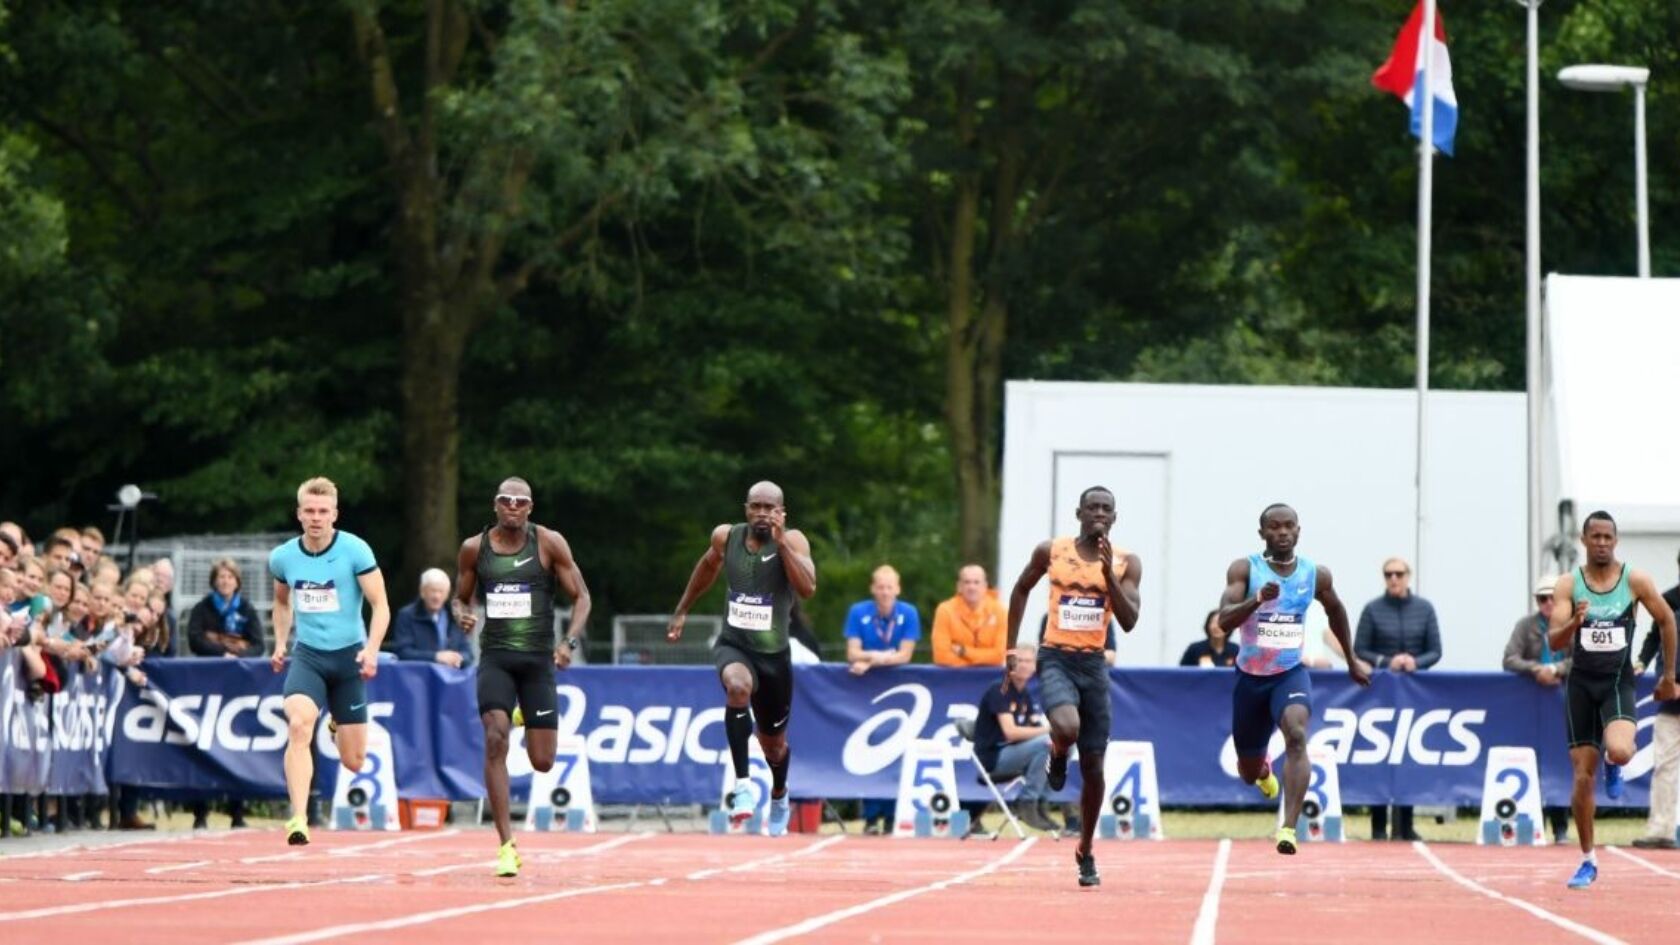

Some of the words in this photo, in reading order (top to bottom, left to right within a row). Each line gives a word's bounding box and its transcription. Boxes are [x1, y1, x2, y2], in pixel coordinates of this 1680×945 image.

[731, 606, 769, 621] Martina
[1063, 610, 1100, 622] Burnet
[1591, 631, 1613, 644] 601
[123, 690, 290, 752] asics
[1309, 708, 1487, 766] asics
[554, 754, 578, 788] 7
[911, 759, 944, 813] 5
[1110, 761, 1148, 816] 4
[1495, 768, 1530, 820] 2
